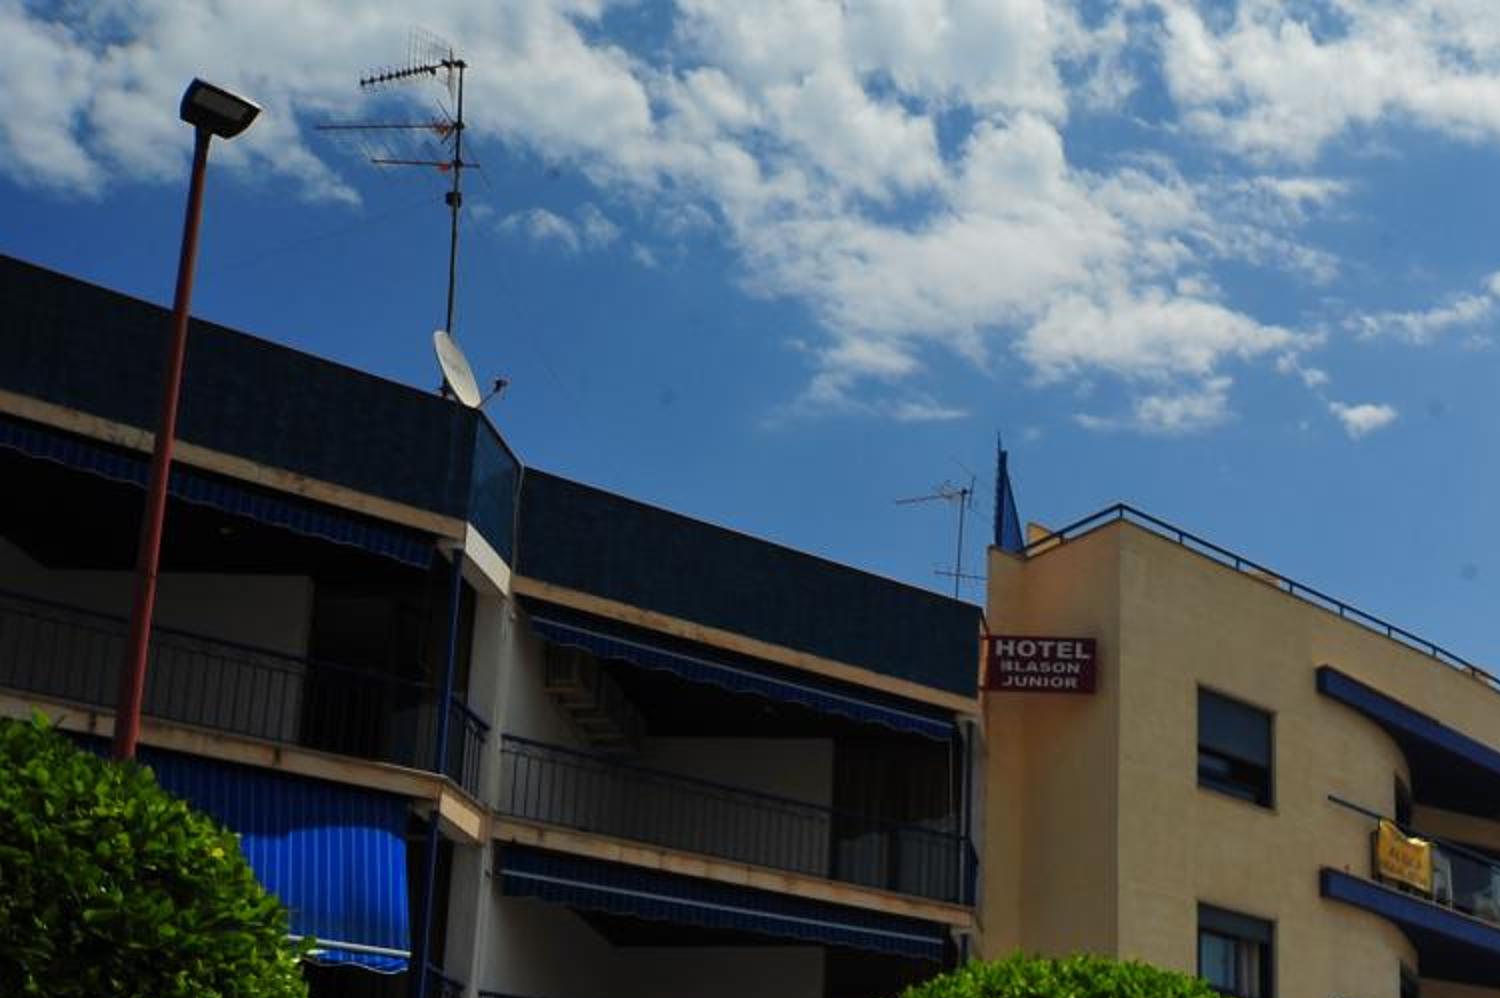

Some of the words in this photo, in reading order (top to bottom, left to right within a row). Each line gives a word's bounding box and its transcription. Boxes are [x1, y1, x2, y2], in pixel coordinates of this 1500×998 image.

[995, 640, 1090, 659] HOTEL
[1001, 660, 1080, 674] BLASON
[1002, 675, 1079, 688] JUNIOR
